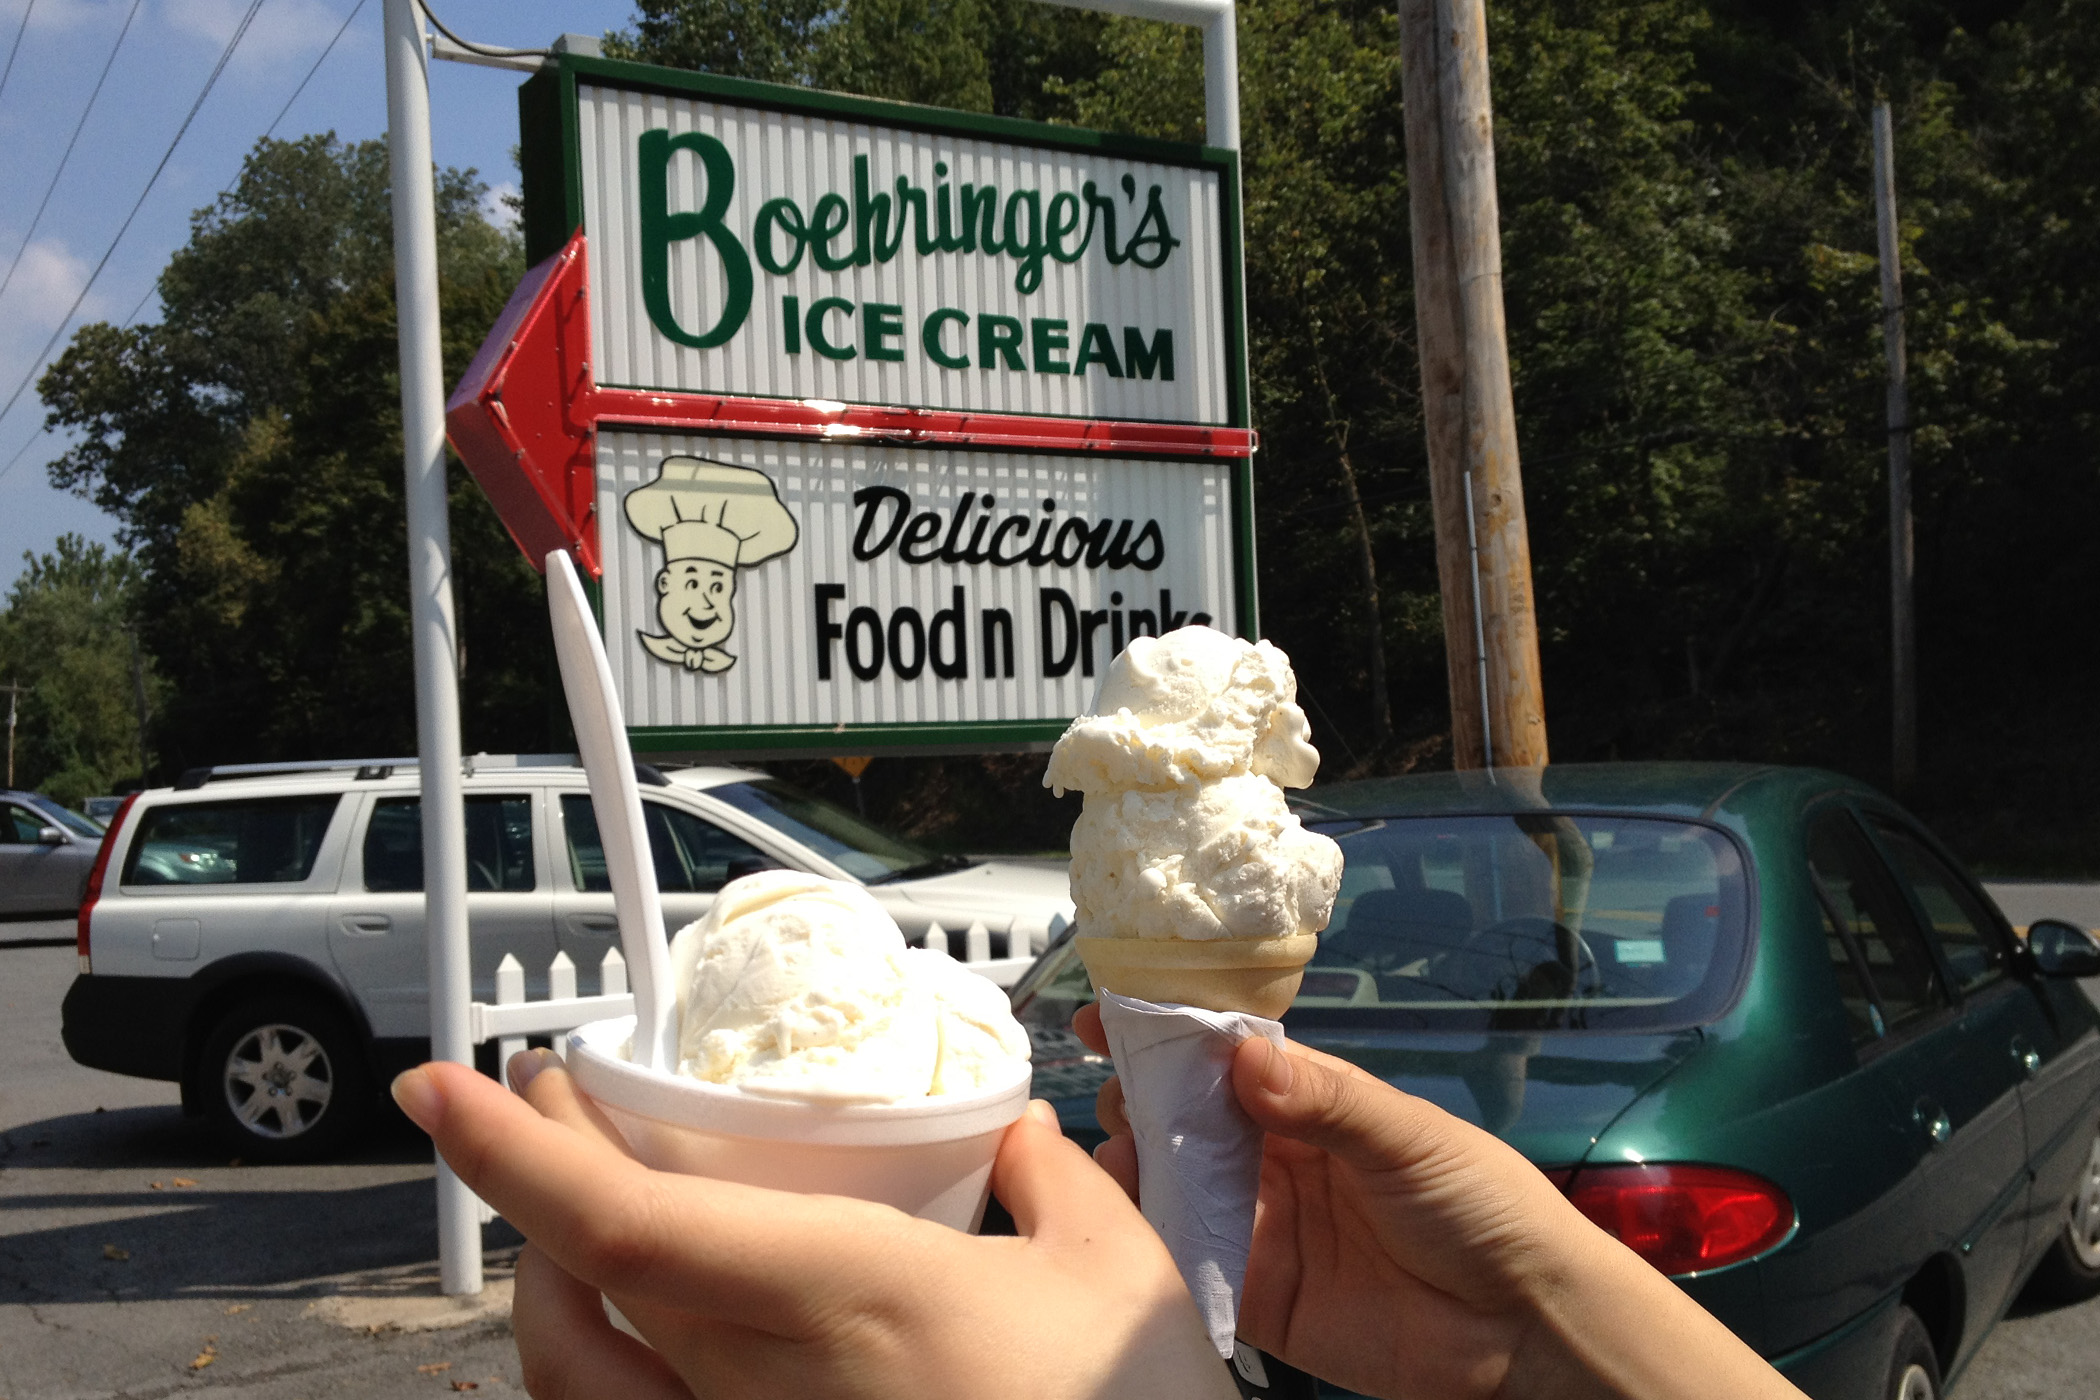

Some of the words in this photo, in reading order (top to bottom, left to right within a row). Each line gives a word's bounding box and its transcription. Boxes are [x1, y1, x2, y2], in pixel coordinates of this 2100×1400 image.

[639, 128, 1181, 349] Boehringer's
[782, 296, 905, 363] ICE
[922, 308, 1176, 382] CREAM
[853, 485, 1166, 572] Delicious
[815, 583, 968, 682] Food
[982, 607, 1015, 679] n
[1040, 587, 1213, 679] Dri
